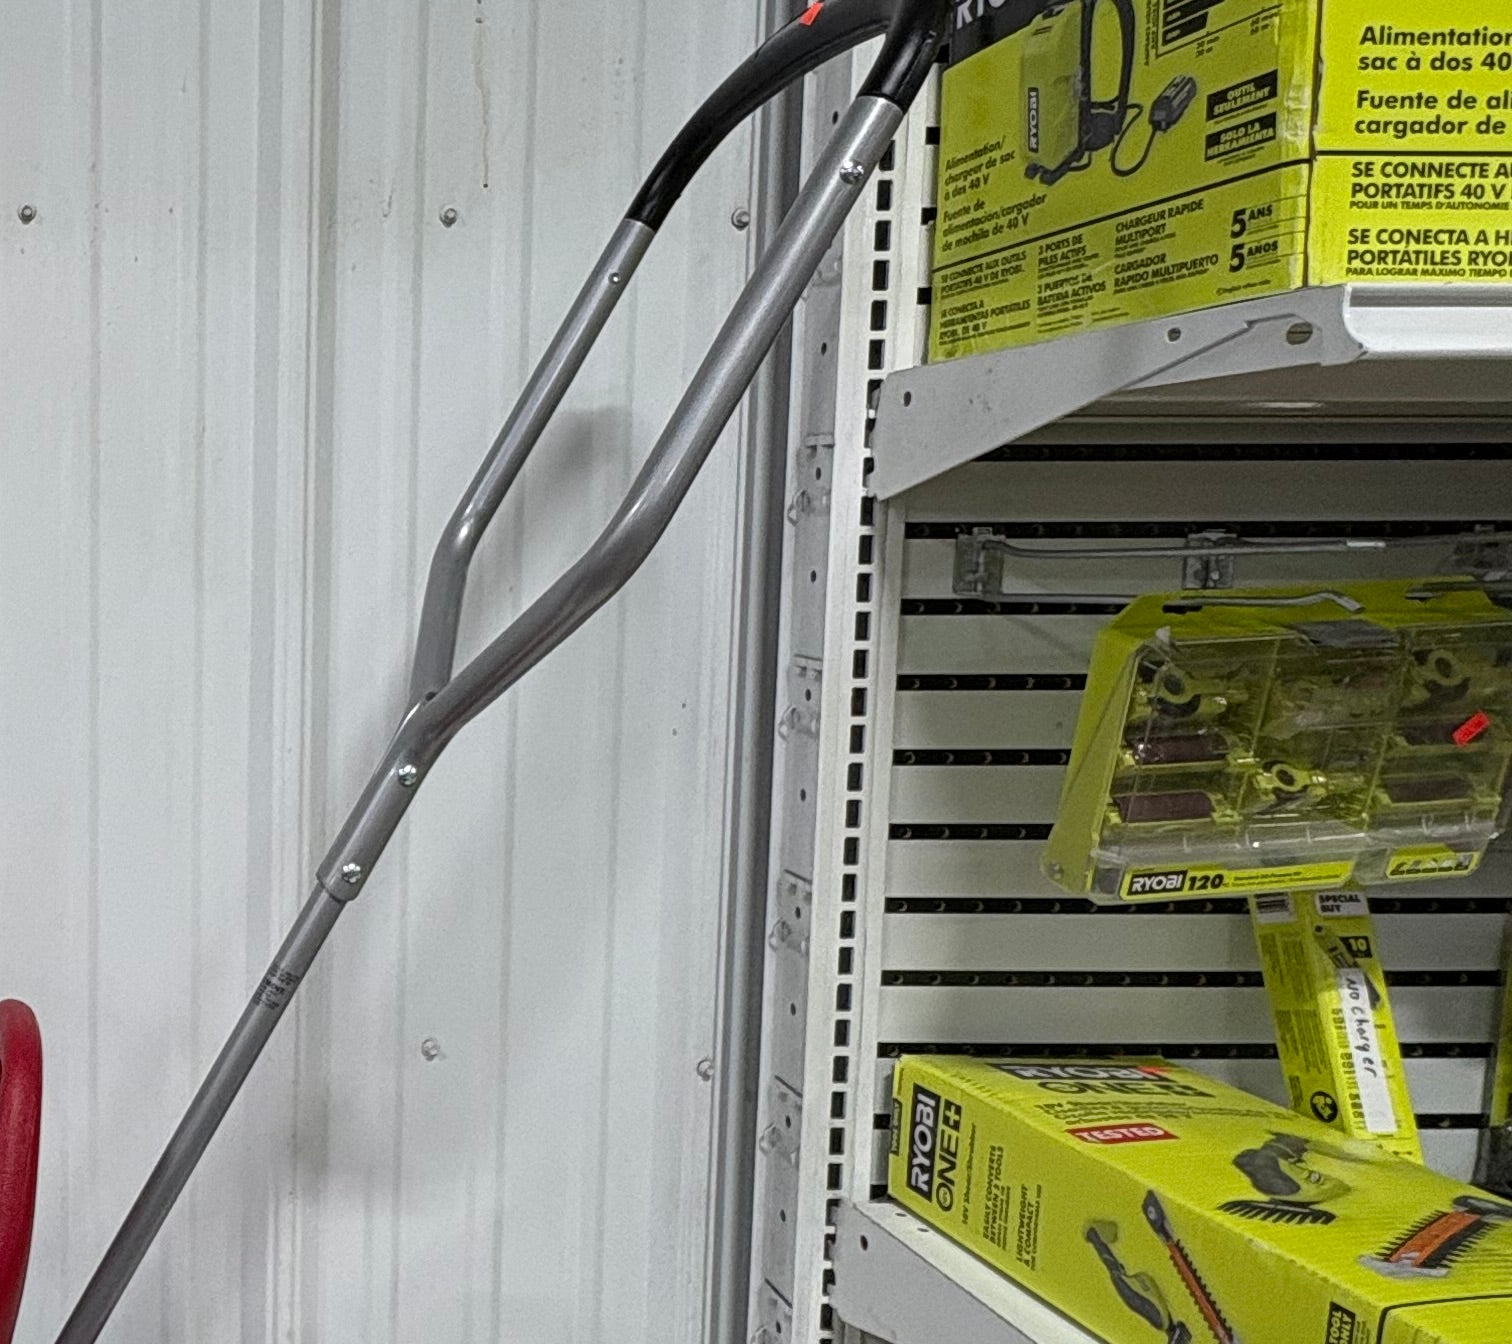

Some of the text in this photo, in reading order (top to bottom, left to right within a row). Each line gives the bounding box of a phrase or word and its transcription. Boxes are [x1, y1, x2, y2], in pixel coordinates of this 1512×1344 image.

[1358, 51, 1512, 71] sac à dos 40
[1357, 90, 1438, 109] Fuente
[1447, 89, 1477, 109] de
[1355, 114, 1506, 139] cargador de
[1352, 162, 1375, 177] SE
[1381, 162, 1489, 178] CONNECTE
[1351, 183, 1506, 199] PORTATIFS 40 V
[1350, 201, 1378, 209] POUR
[1401, 201, 1433, 209] TEMPS
[1436, 201, 1509, 210] D'AUTONOMIE
[1116, 199, 1204, 233] CHARGEUR RAPIDE
[1230, 205, 1272, 239] 5 ANS
[1115, 223, 1166, 246] MULTIPORT
[1348, 229, 1370, 244] SE
[1376, 229, 1469, 245] CONECTA
[1474, 230, 1489, 245] A
[1114, 253, 1166, 275] CARGADOR
[1229, 244, 1245, 273] 5
[1347, 246, 1461, 265] PORTÁTILES
[1151, 254, 1219, 279] MULTIPUERTO
[1346, 268, 1374, 276] PARA
[1376, 268, 1418, 276] LOGRAR
[1469, 269, 1507, 277] TIEMPO
[1131, 875, 1182, 892] RYOBI
[1189, 874, 1224, 891] 120
[1319, 894, 1360, 903] SPECIAL
[1349, 939, 1367, 950] 10
[1001, 1065, 1160, 1080] RYOBI
[911, 1093, 935, 1192] RYOBI
[1075, 1125, 1165, 1143] TESTED
[995, 1146, 1003, 1181] TOOLS
[1016, 1184, 1028, 1263] LIGHTWEIGHT
[1024, 1201, 1034, 1256] COMPACT
[1329, 1311, 1341, 1344] TOOL
